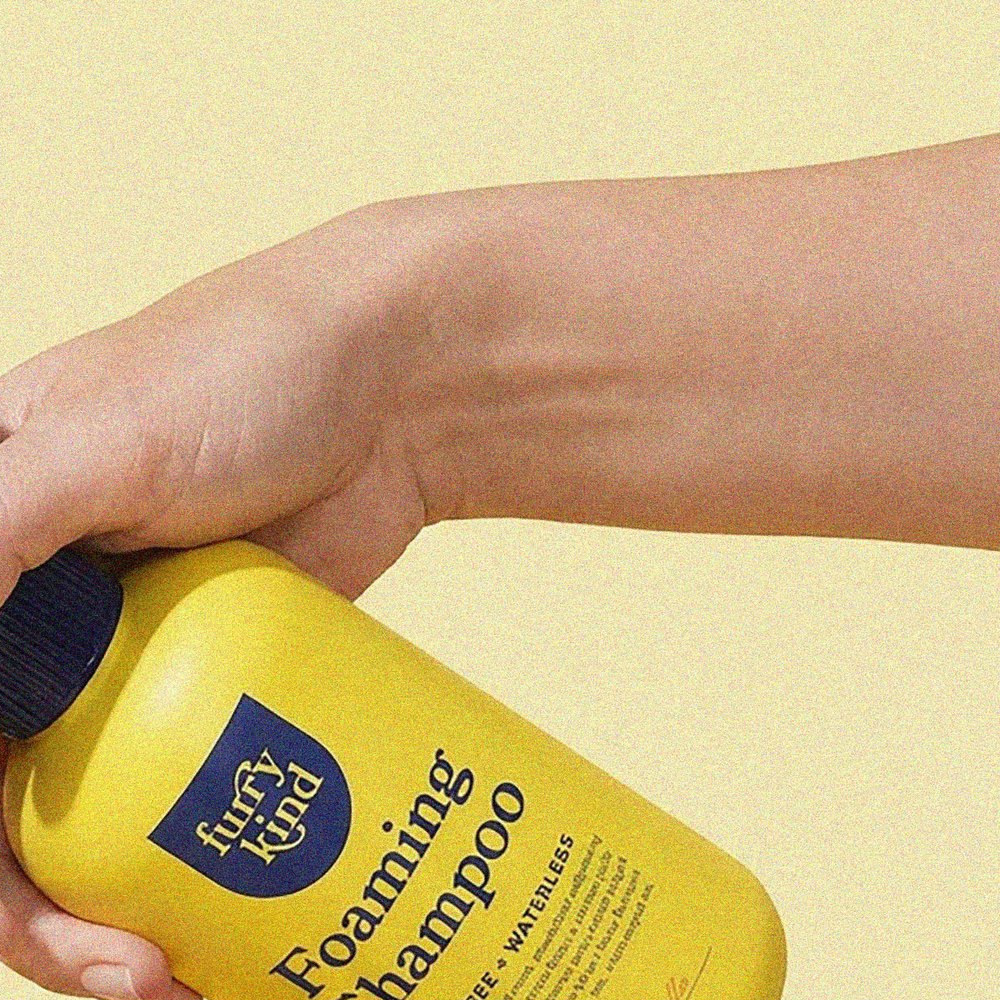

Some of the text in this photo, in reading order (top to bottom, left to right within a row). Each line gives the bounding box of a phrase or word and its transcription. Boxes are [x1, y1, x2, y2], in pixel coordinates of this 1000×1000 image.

[196, 748, 285, 857] furry
[239, 762, 324, 865] kind
[269, 748, 474, 1000] Foaming
[503, 833, 574, 953] WATERLESS
